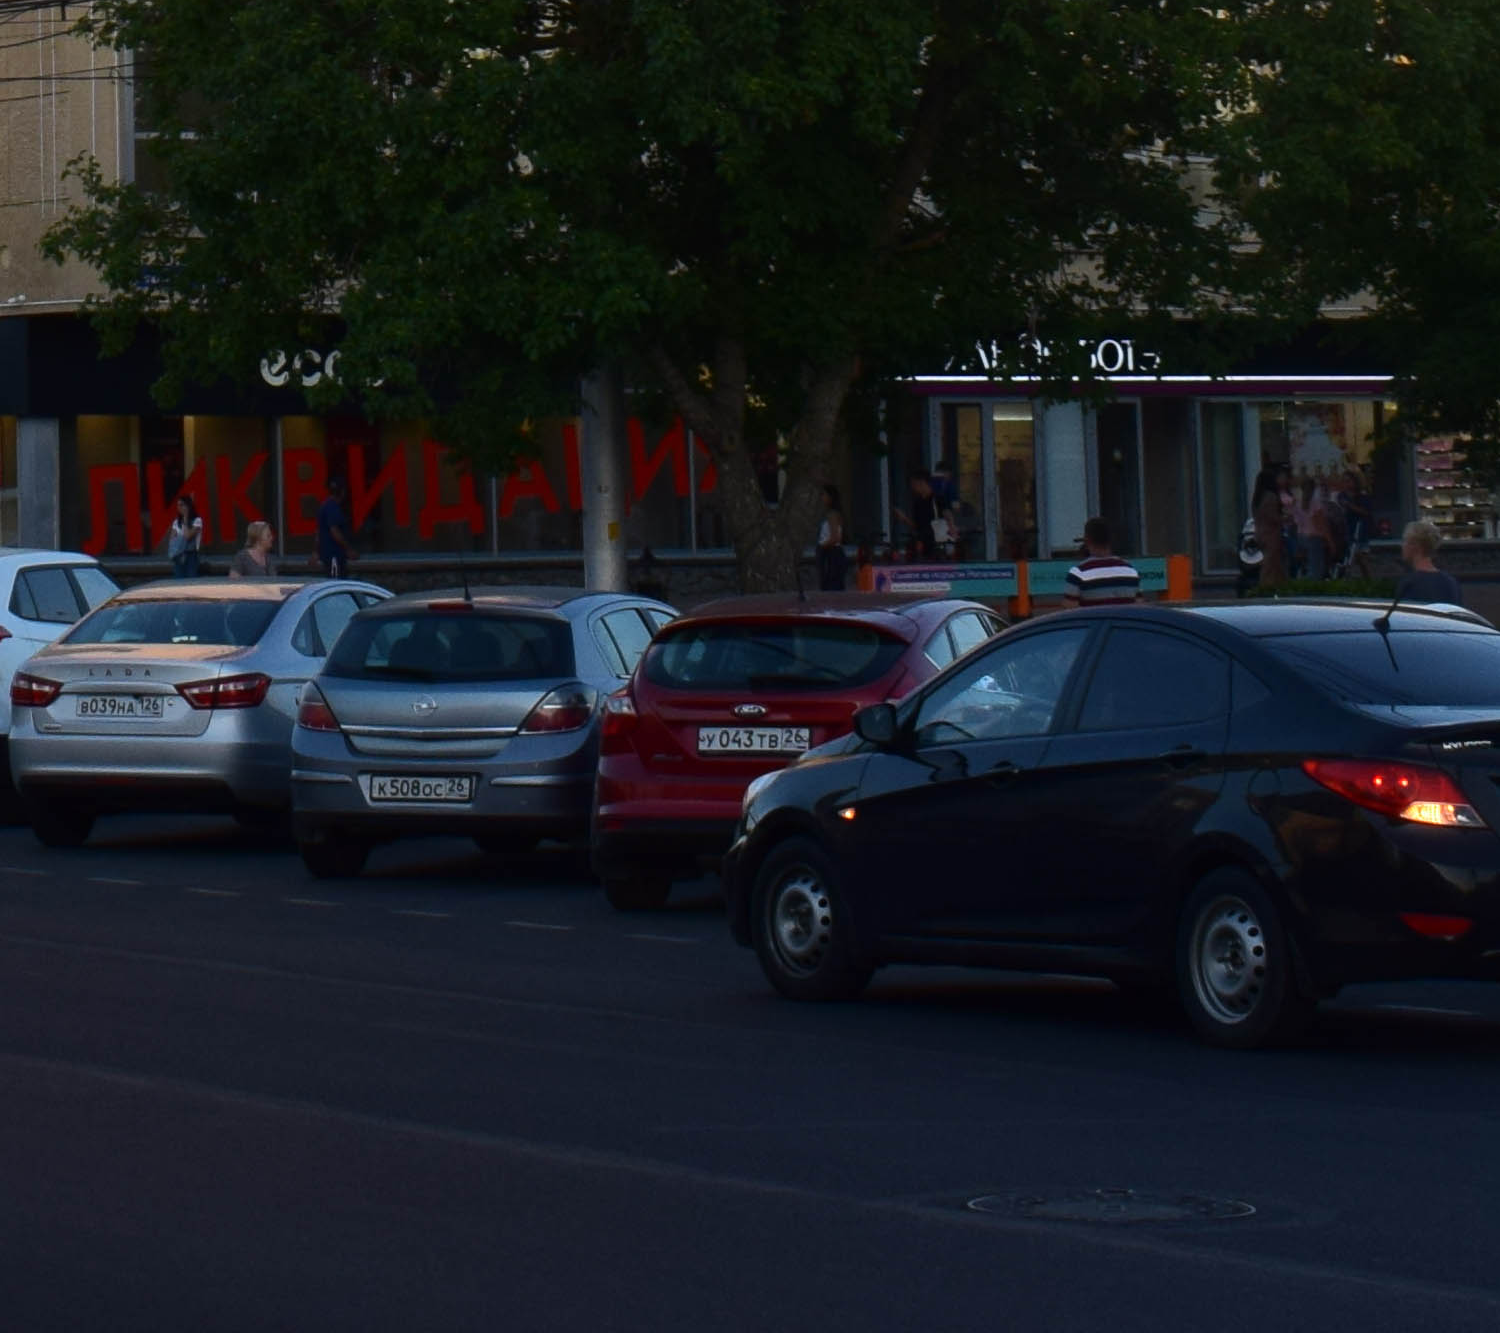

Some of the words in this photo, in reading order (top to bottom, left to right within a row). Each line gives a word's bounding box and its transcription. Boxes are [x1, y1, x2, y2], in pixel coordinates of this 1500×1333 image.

[88, 669, 151, 677] LADA
[80, 698, 135, 715] В039НА
[138, 697, 159, 711] 126
[706, 729, 779, 749] У043ТВ
[378, 779, 443, 797] К508ОС
[447, 779, 465, 792] 26
